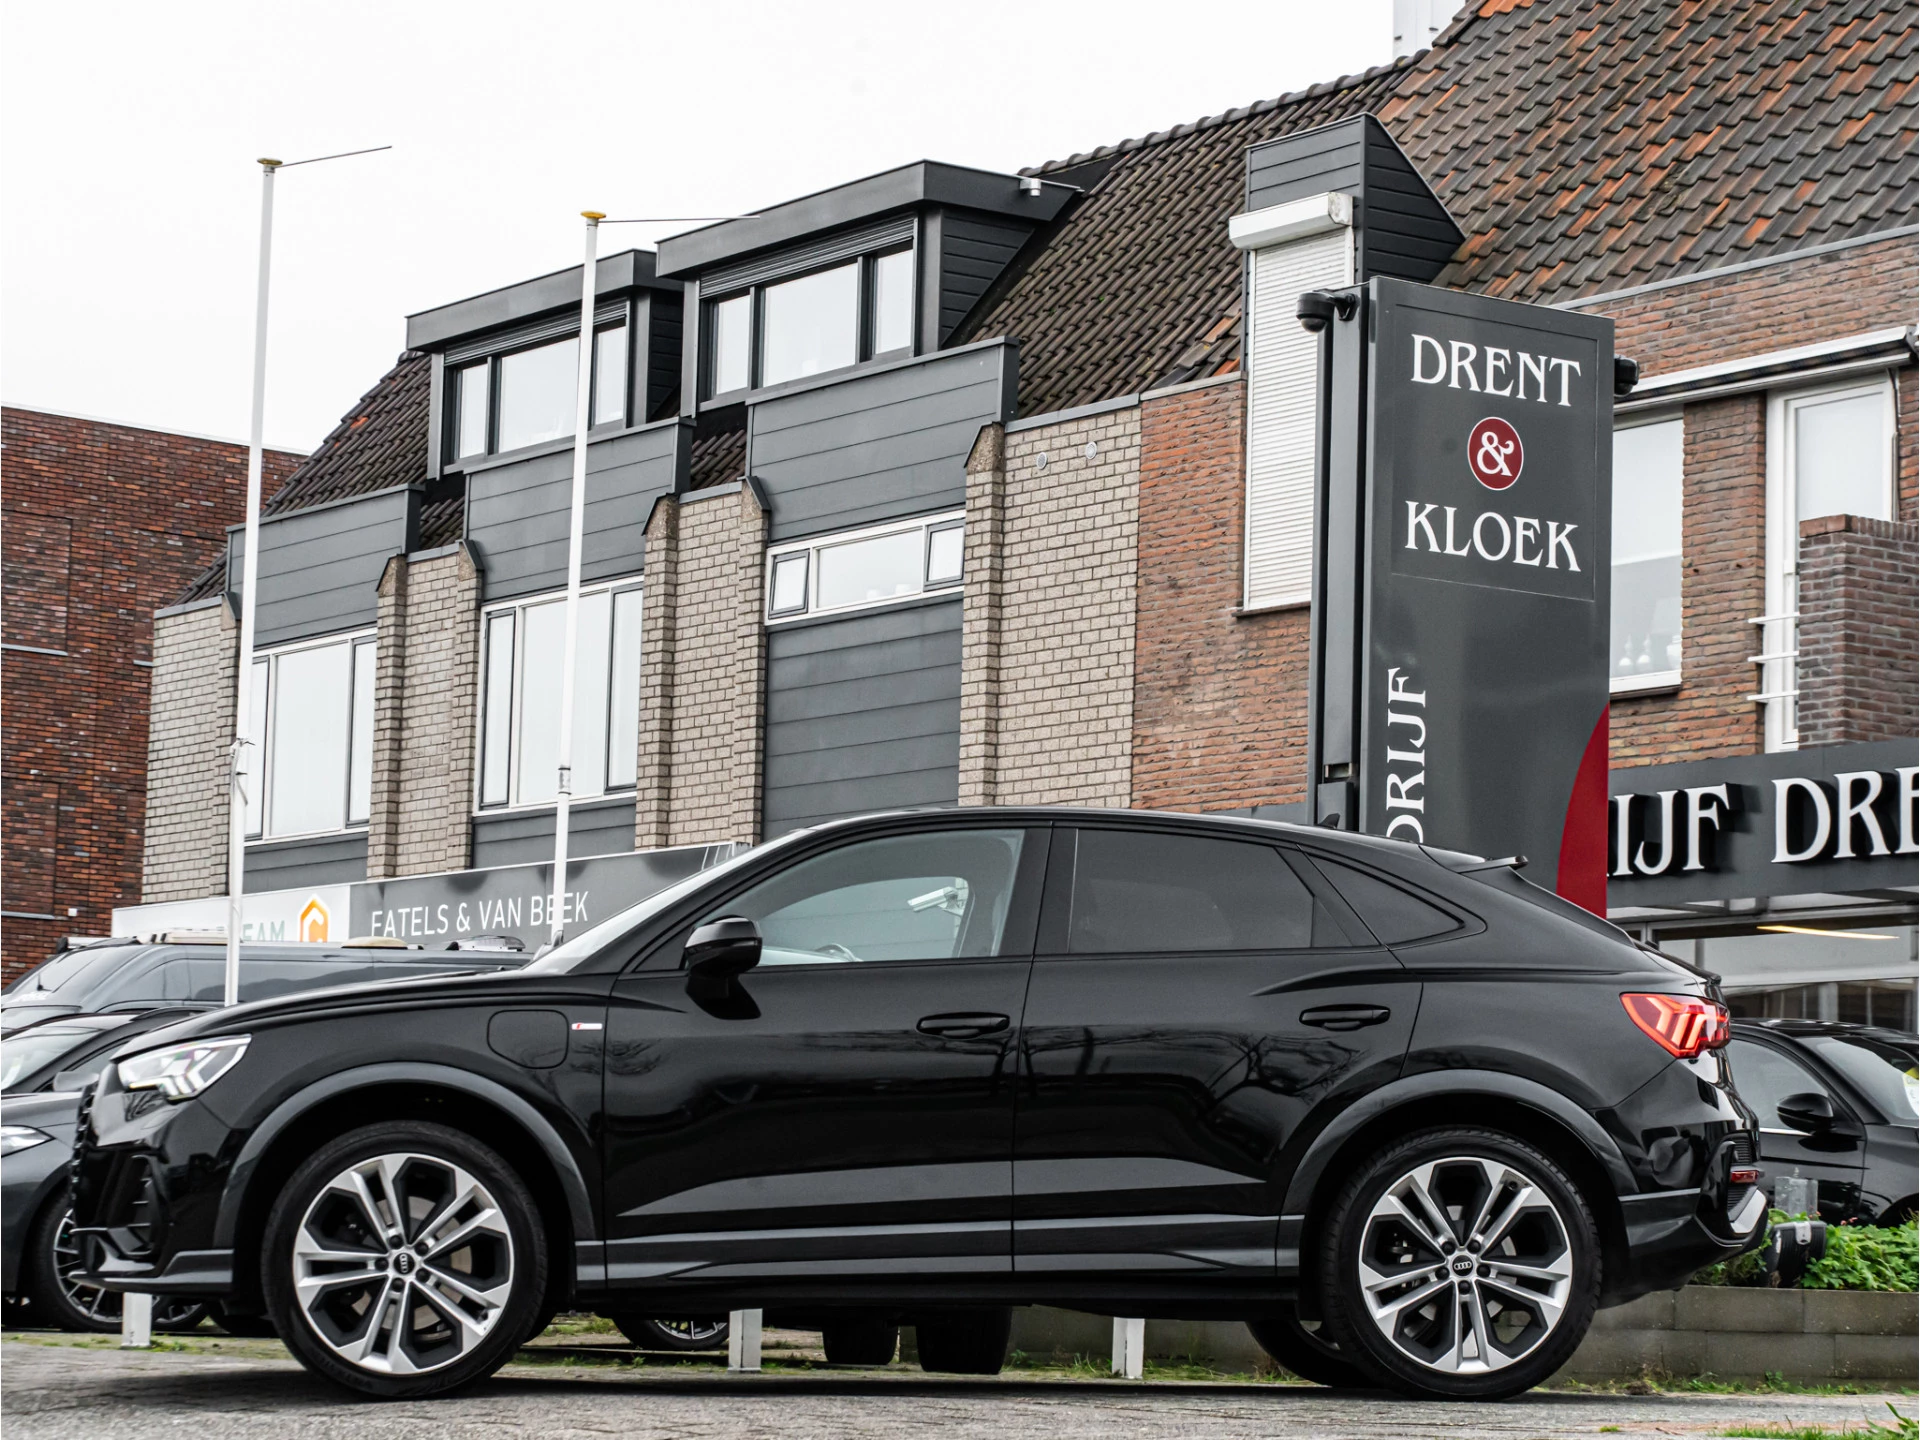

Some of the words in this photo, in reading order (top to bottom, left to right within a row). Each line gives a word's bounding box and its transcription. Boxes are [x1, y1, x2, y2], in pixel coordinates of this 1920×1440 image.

[1411, 333, 1582, 407] DRENT
[1476, 431, 1515, 477] &
[1404, 500, 1582, 572] KLOEK
[1606, 783, 1730, 877] IJF
[456, 902, 471, 932] &
[479, 896, 522, 930] VAN
